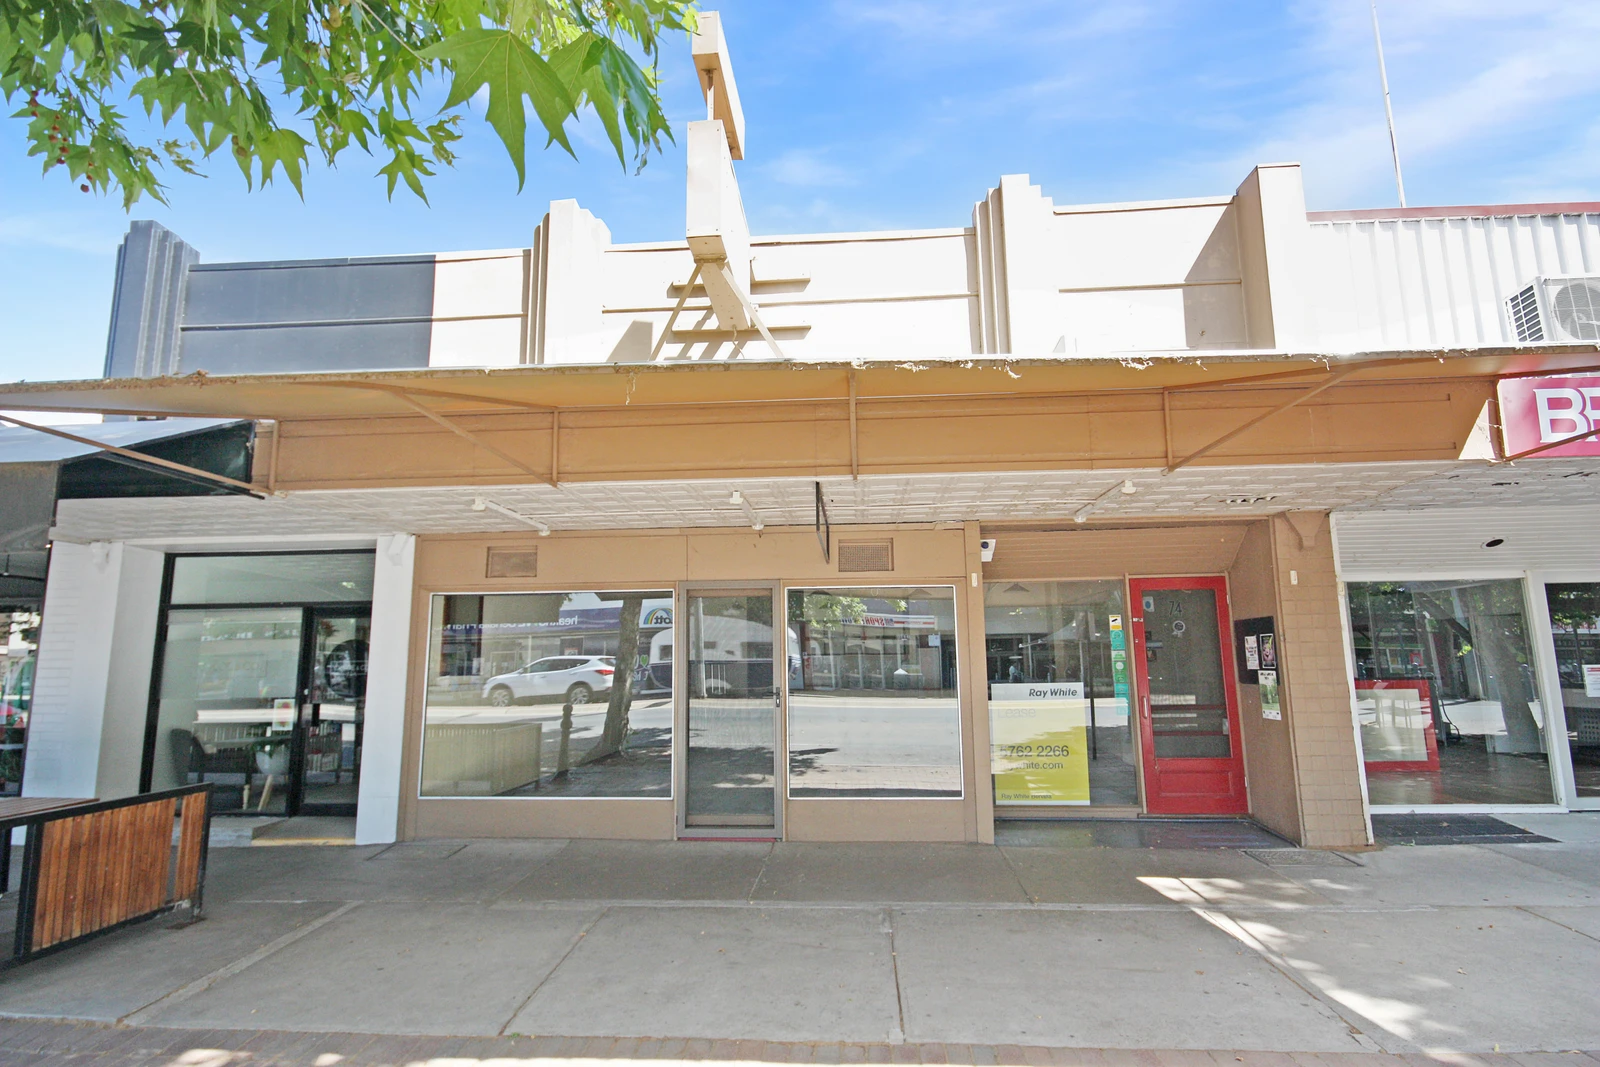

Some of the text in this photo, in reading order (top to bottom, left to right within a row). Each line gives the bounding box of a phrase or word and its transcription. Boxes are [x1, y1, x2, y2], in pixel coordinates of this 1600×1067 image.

[1168, 600, 1182, 616] 74
[1028, 688, 1078, 698] Ray White
[997, 706, 1036, 718] Lease
[999, 745, 1070, 757] 5762 2266
